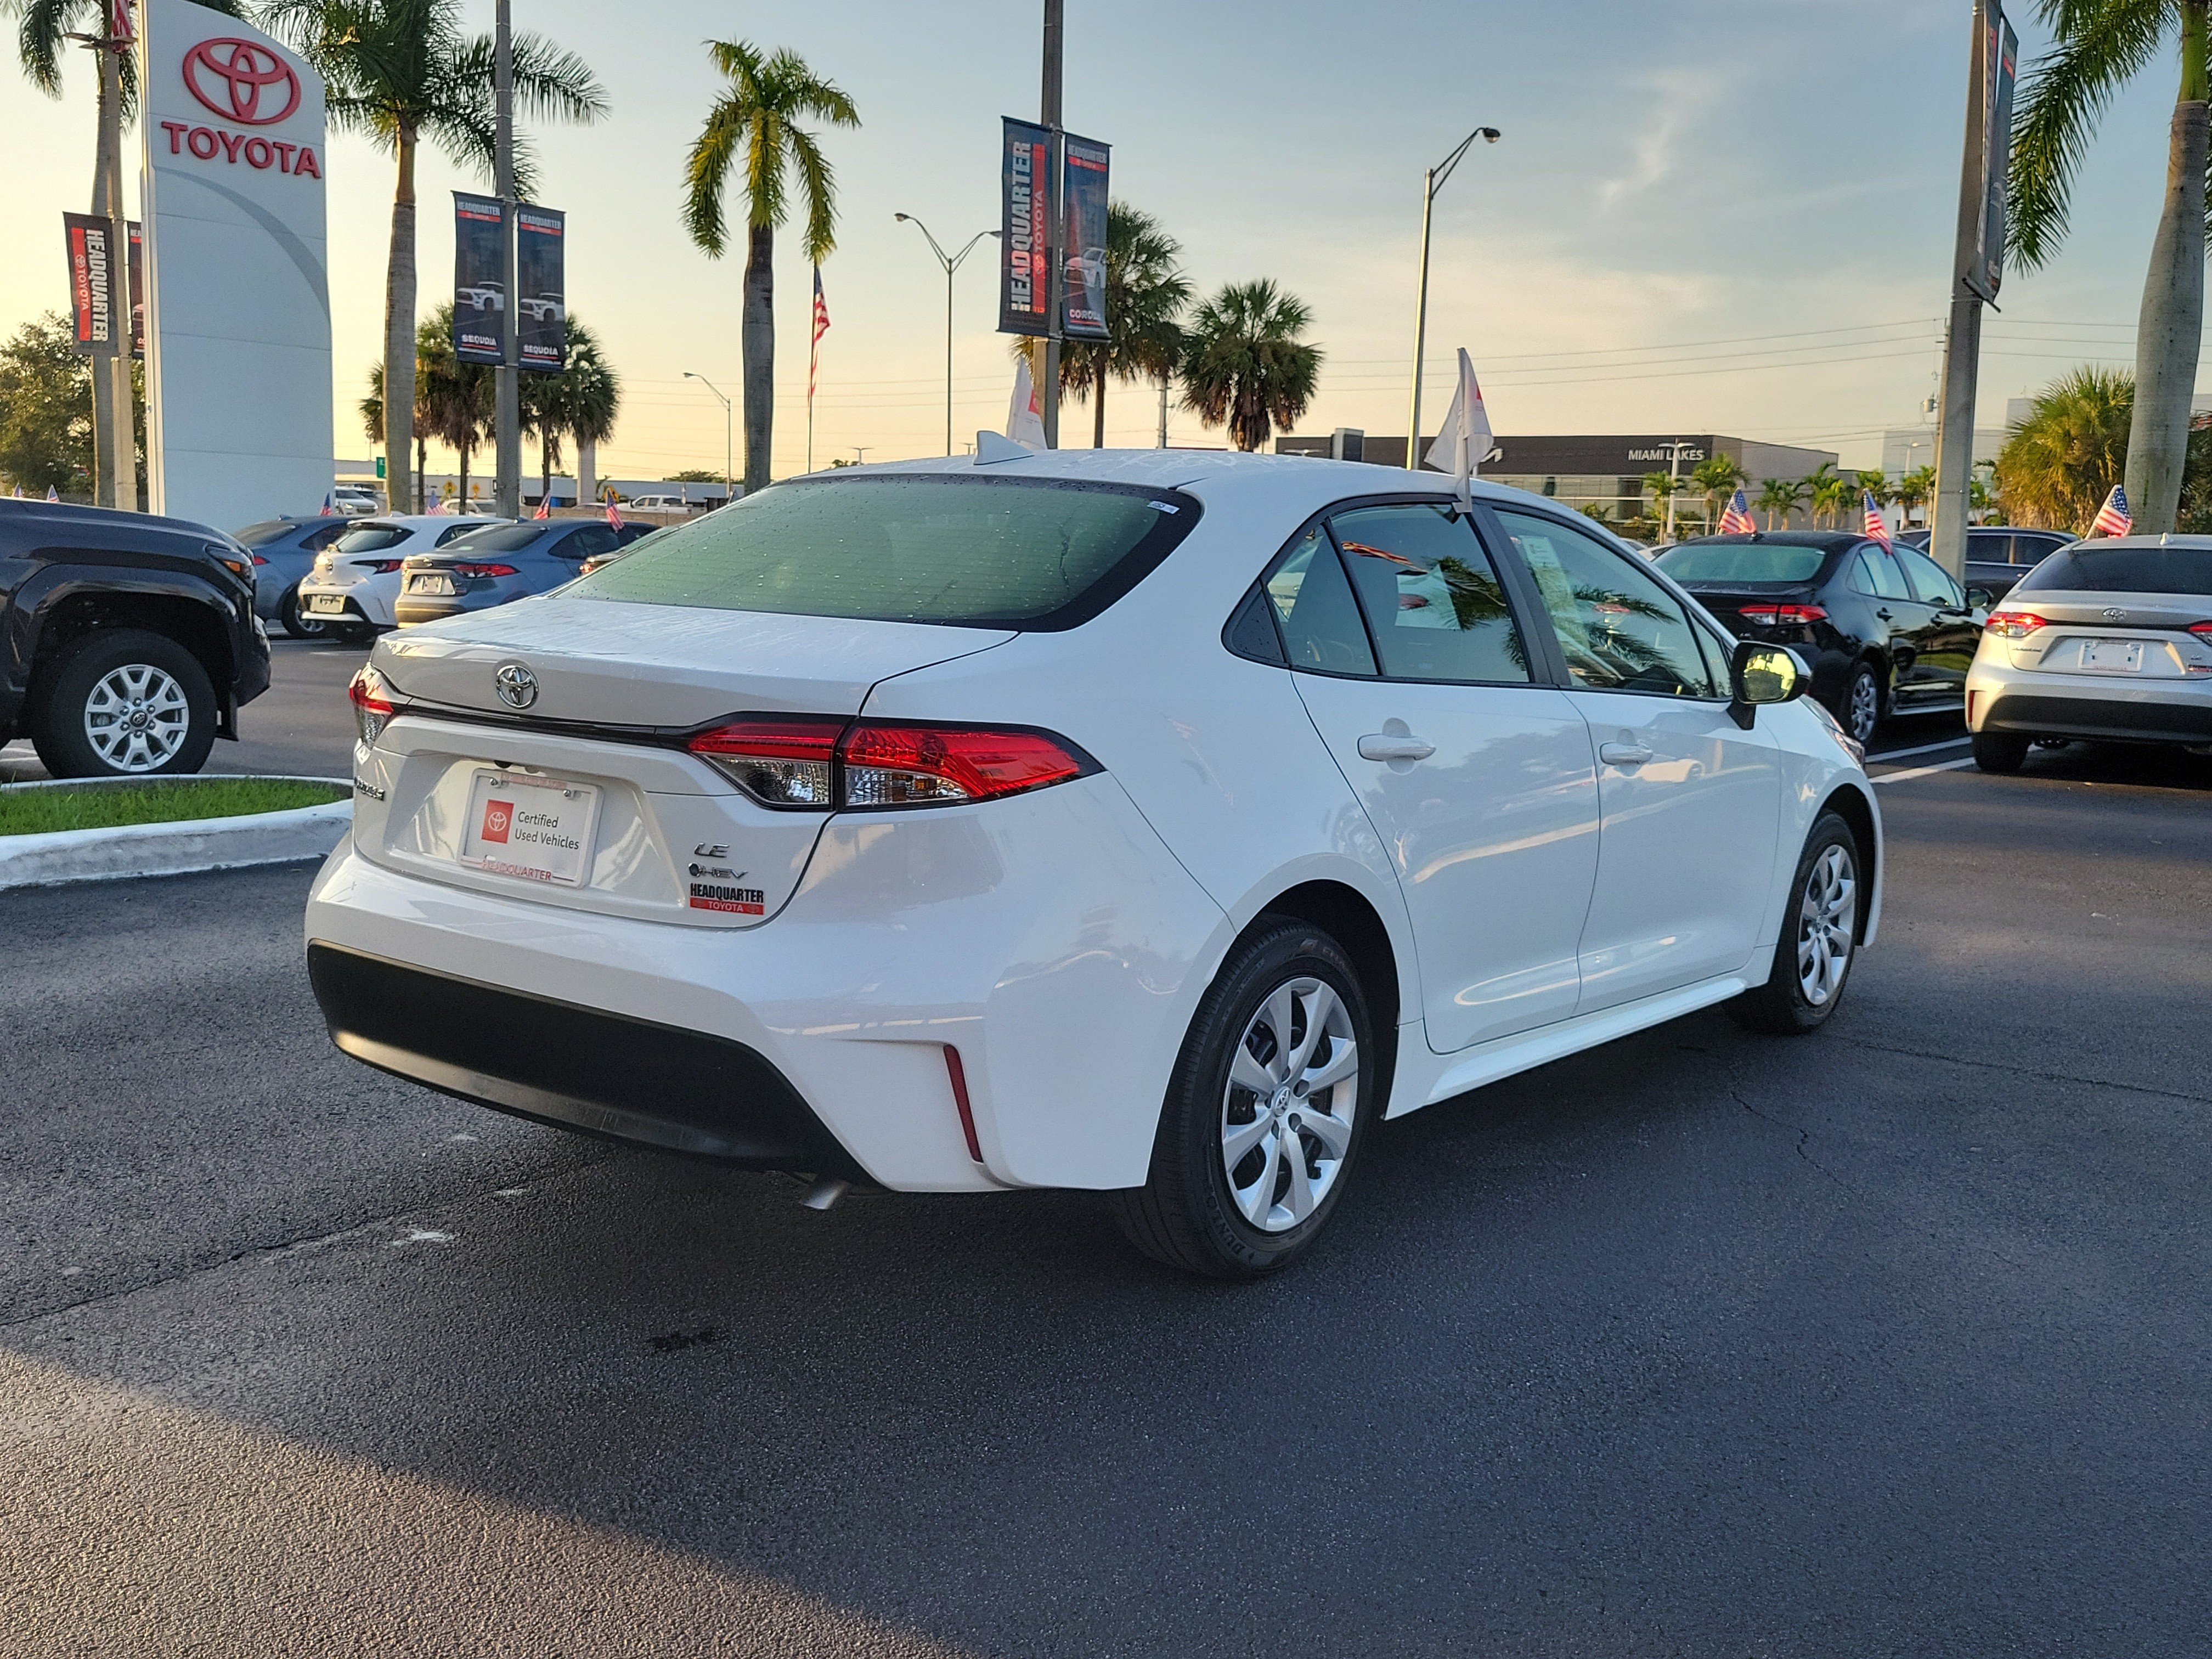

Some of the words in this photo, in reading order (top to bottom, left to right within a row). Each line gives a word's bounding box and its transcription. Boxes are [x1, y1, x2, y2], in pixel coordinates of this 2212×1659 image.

[161, 121, 321, 179] TOYOTA
[1012, 141, 1032, 311] HEADQUARTER
[1035, 191, 1043, 252] TOYOTA
[76, 268, 89, 311] TOYOTA
[86, 229, 109, 342] HEADQUARTER
[461, 334, 497, 346] SEQUOIA
[523, 344, 558, 356] SEQUOIA
[1628, 449, 1664, 460] MIAMI
[517, 811, 559, 828] Certified
[515, 828, 539, 843] Used
[540, 832, 579, 850] Vehicles
[694, 842, 730, 858] LE
[690, 883, 764, 904] HEADQUARTER
[708, 901, 743, 912] TOYOTA
